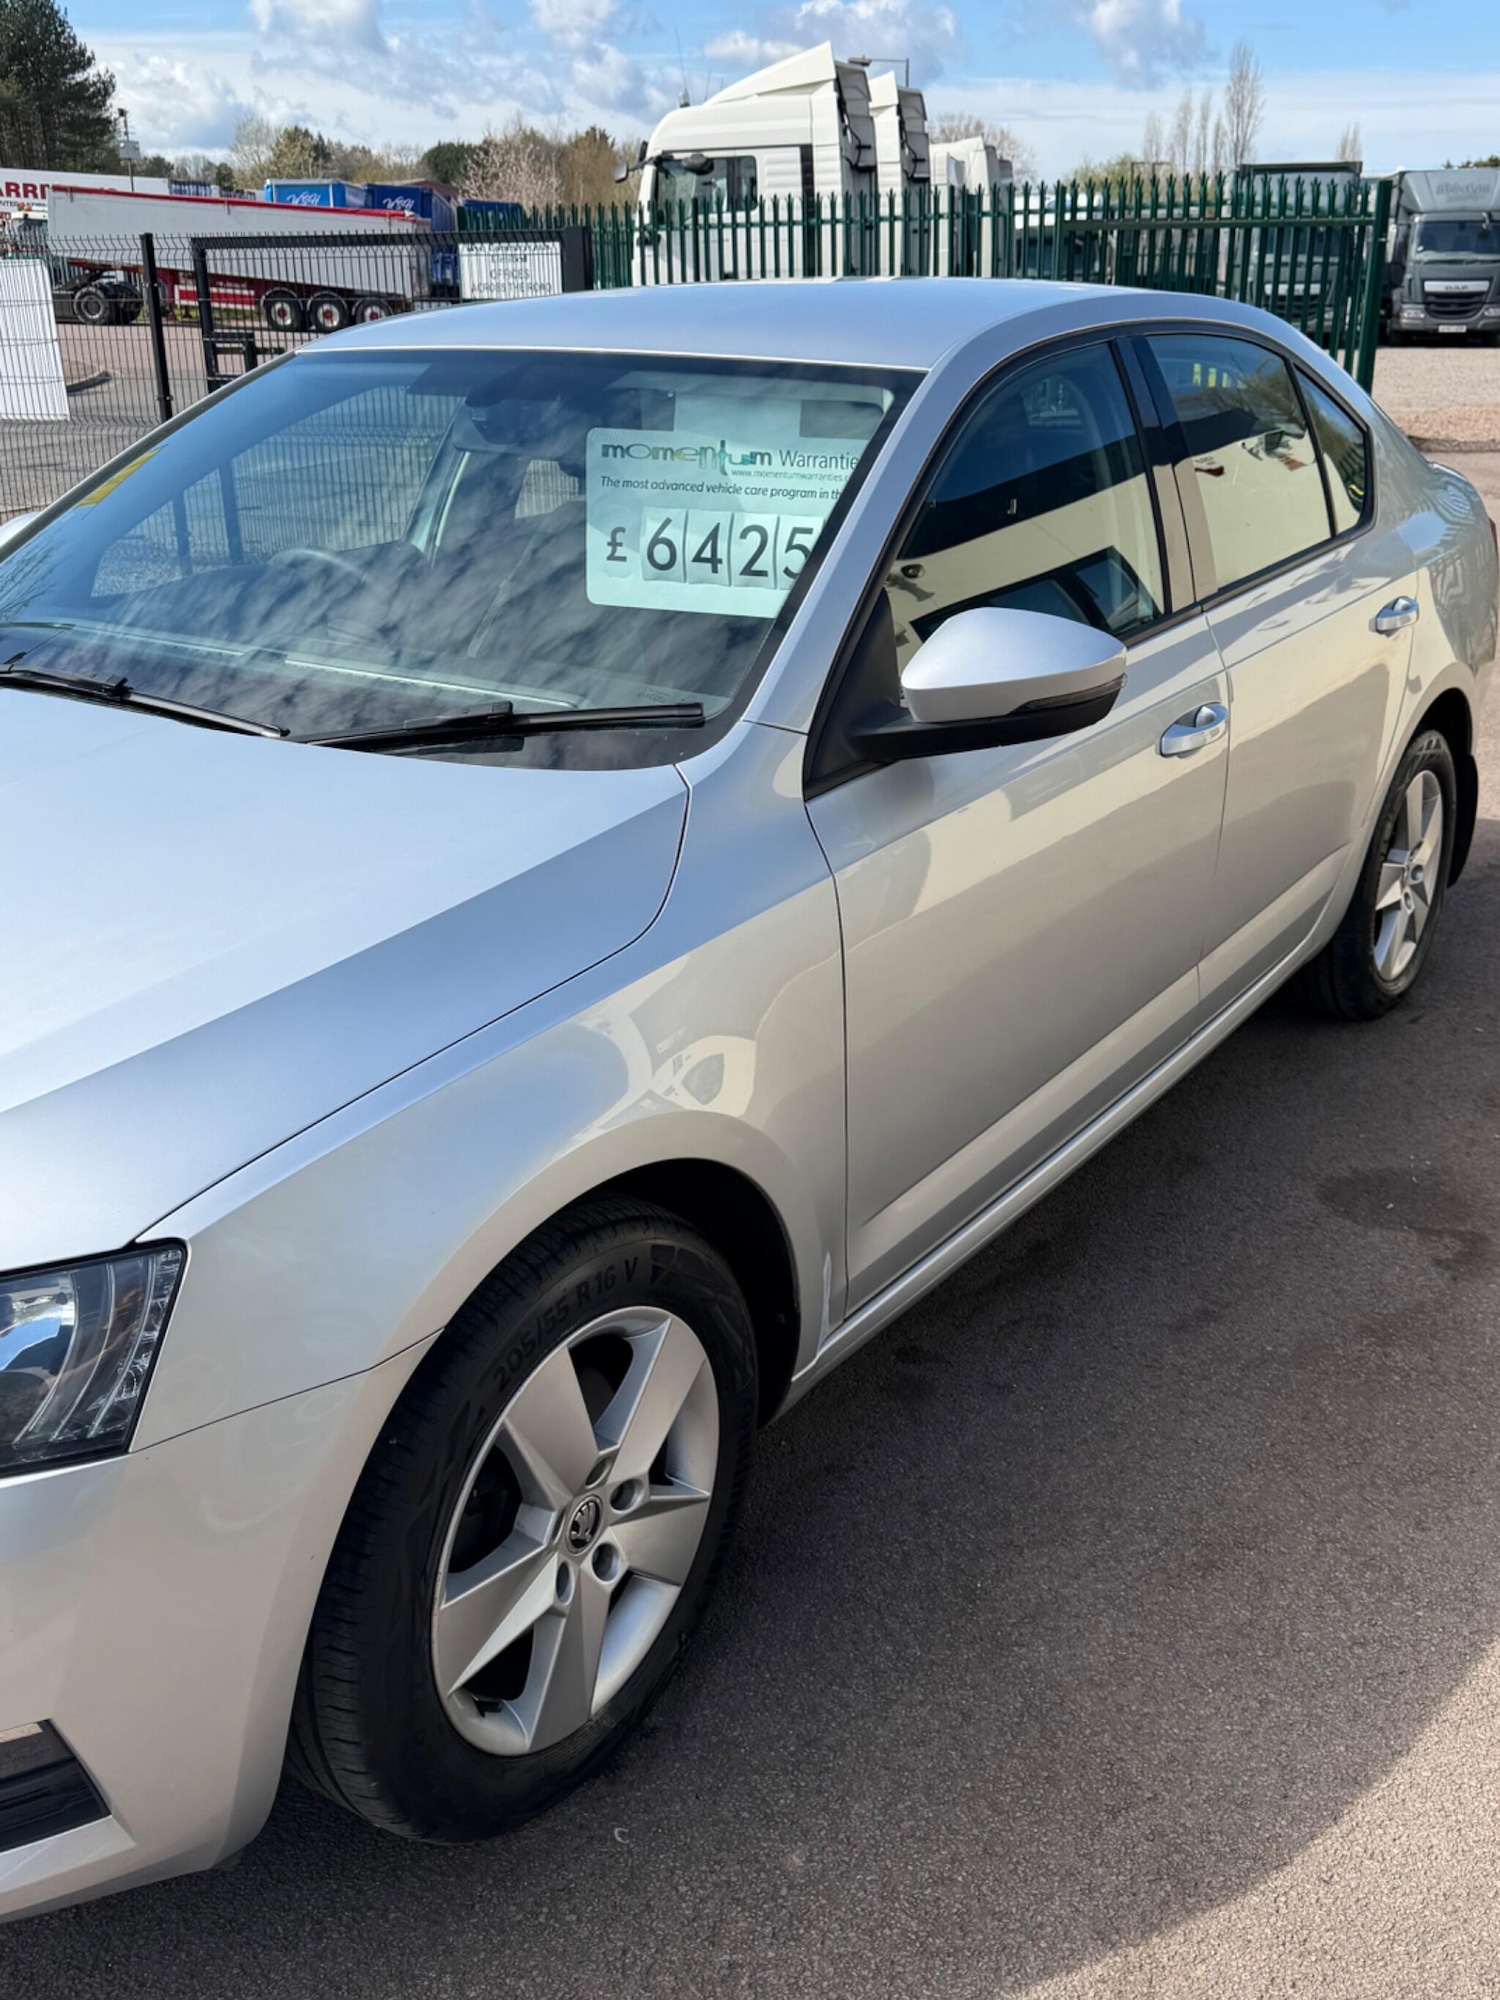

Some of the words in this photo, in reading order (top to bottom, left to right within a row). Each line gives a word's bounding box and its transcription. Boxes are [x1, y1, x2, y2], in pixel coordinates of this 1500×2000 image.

[601, 440, 772, 476] momentum
[601, 476, 620, 488] The
[621, 479, 649, 490] most
[651, 480, 704, 493] advanced
[706, 483, 742, 495] vehicle
[744, 485, 768, 497] care
[770, 487, 817, 500] program
[819, 488, 829, 499] in
[493, 1297, 570, 1391] 205/55
